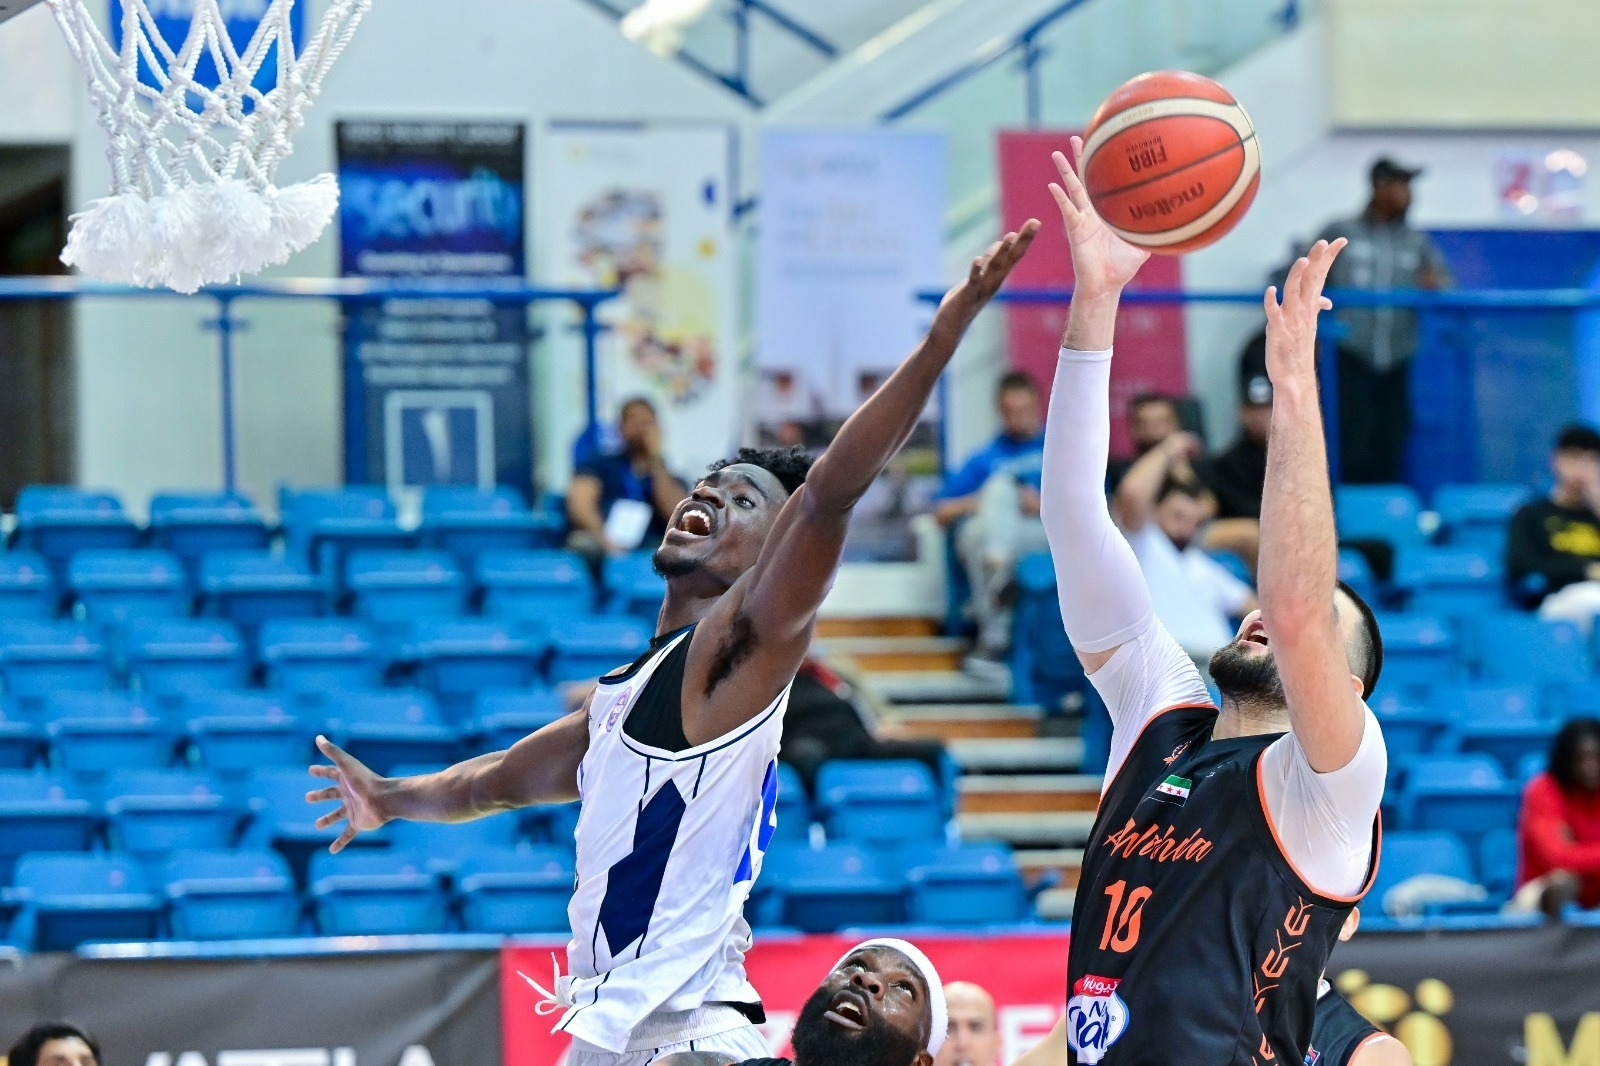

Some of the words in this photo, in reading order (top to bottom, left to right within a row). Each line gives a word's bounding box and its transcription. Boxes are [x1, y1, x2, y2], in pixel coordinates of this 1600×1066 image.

[1127, 146, 1168, 173] FIBA
[1127, 182, 1205, 219] molten
[1098, 879, 1153, 953] 10
